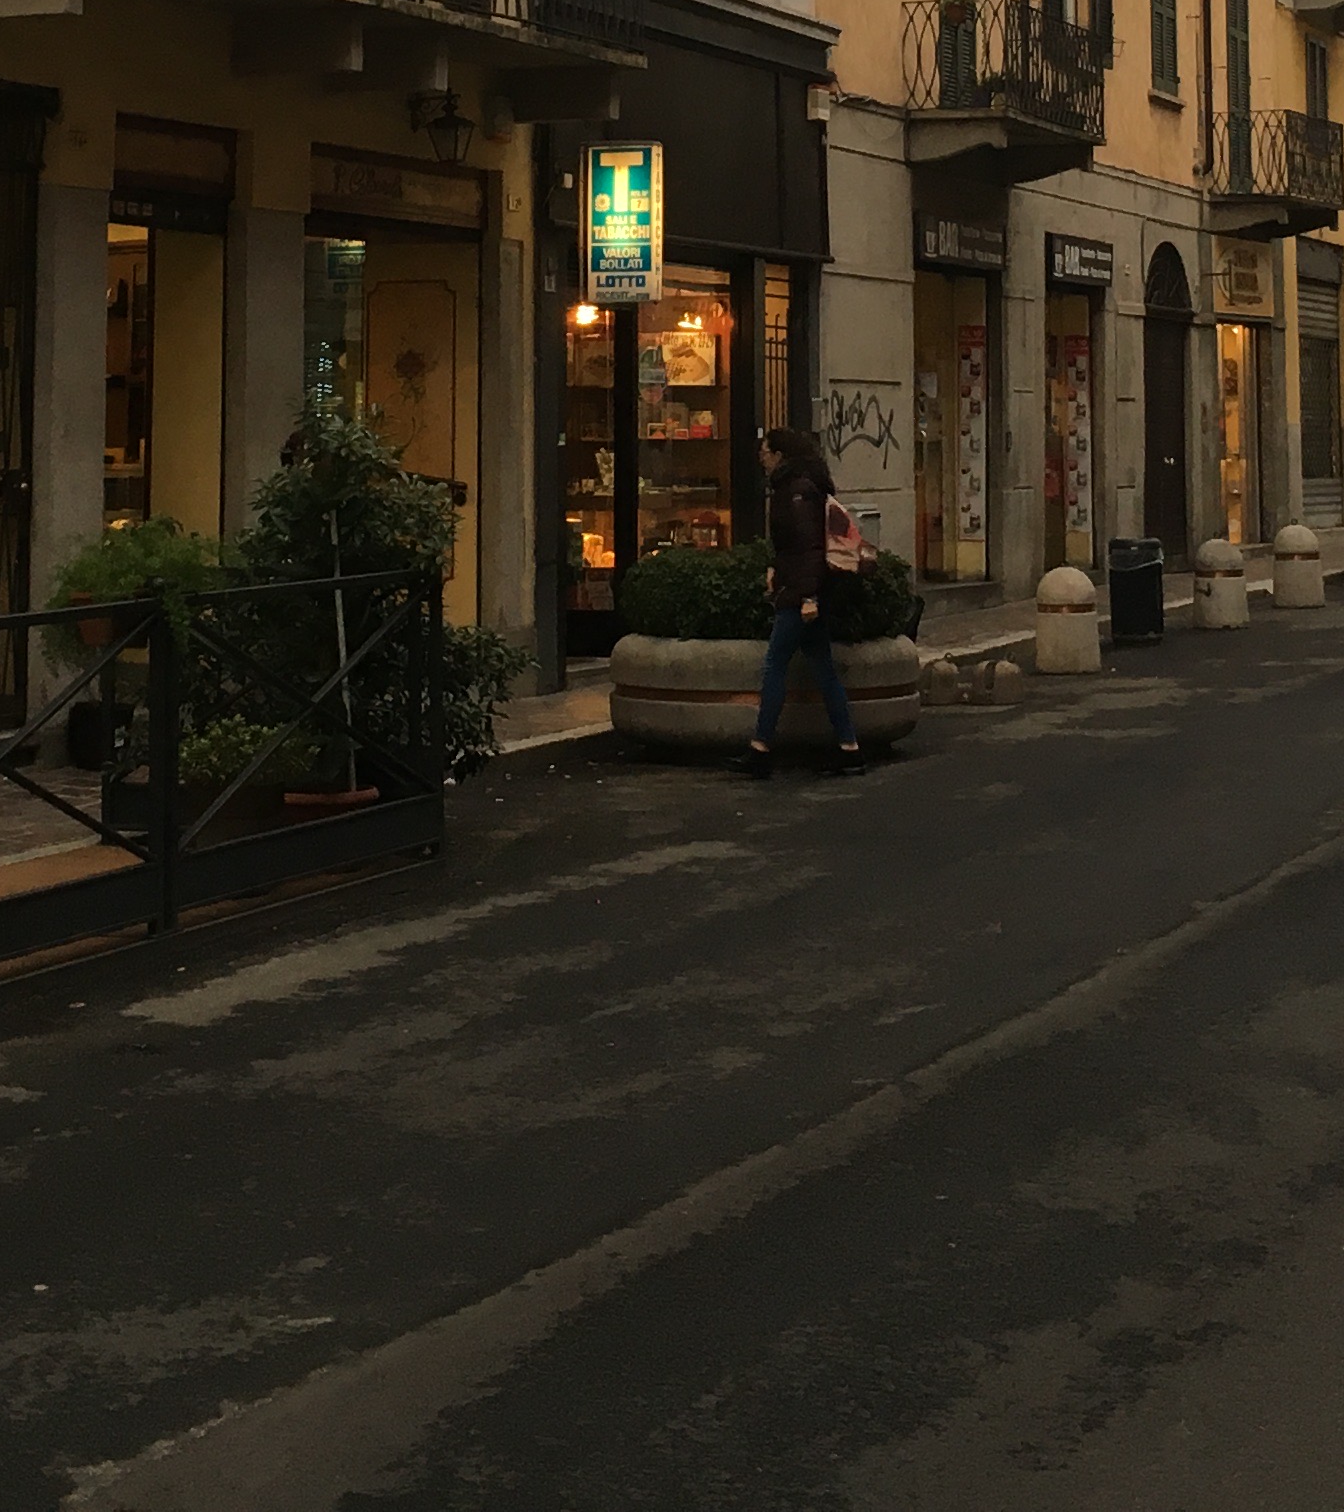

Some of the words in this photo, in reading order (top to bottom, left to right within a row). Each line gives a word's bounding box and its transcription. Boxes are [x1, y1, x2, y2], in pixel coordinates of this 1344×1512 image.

[593, 225, 650, 239] TABACCHI
[603, 247, 641, 258] VALORI
[599, 259, 644, 269] BOLLATI
[597, 275, 646, 287] LOTTO
